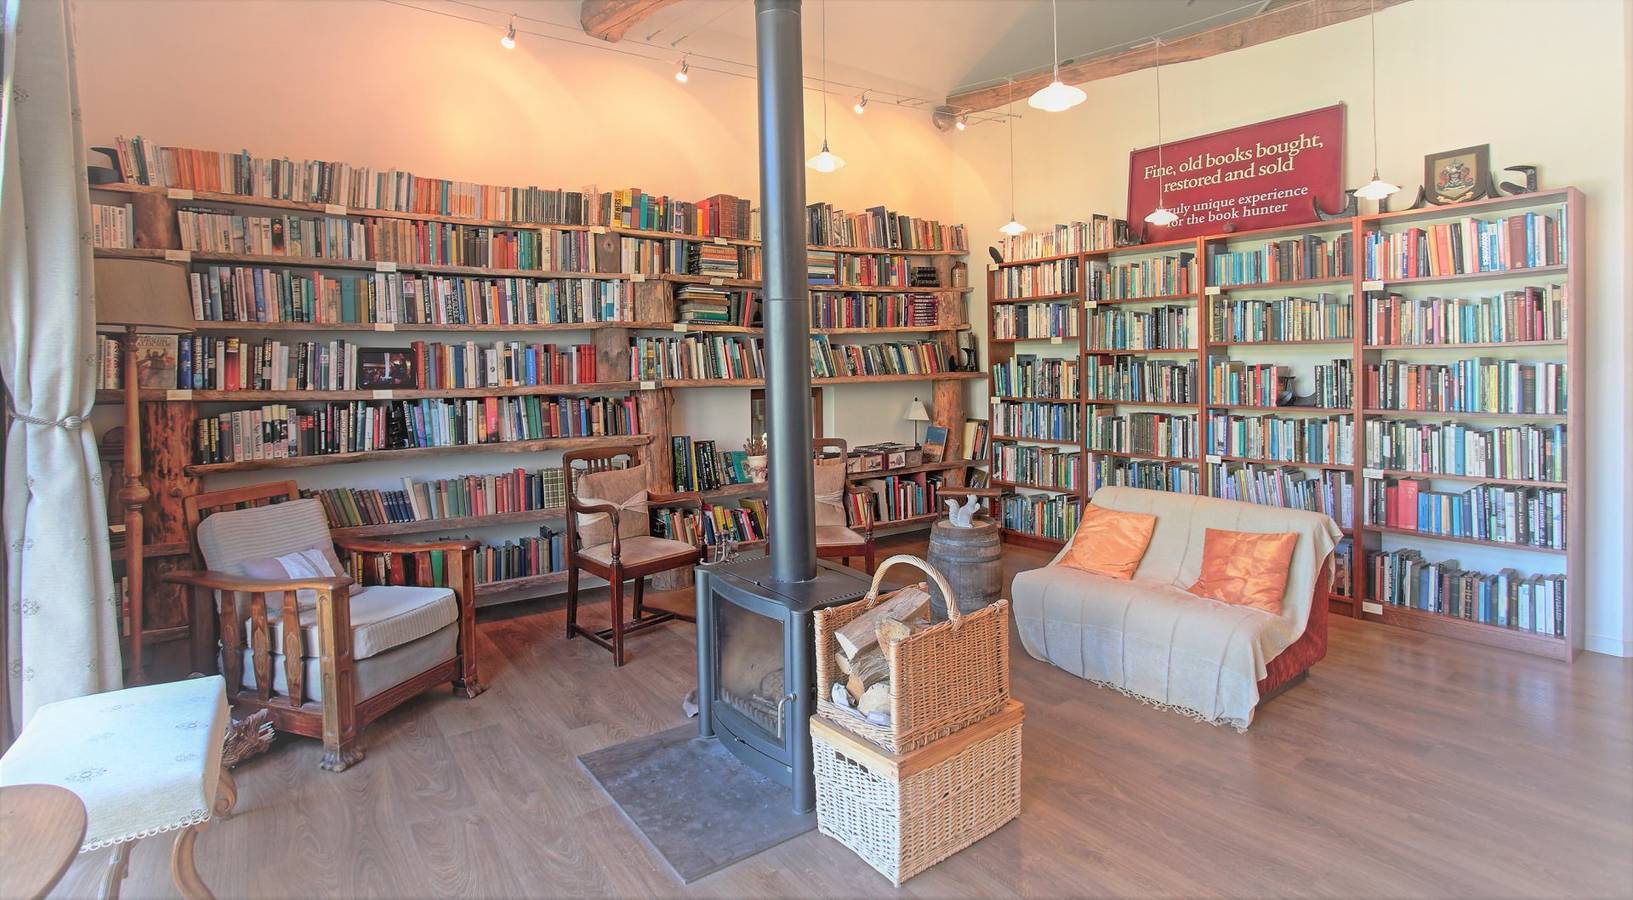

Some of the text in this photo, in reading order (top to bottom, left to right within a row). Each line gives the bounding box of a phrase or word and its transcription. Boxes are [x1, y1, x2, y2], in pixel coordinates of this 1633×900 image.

[1144, 133, 1323, 180] Fine, old books bought,
[1164, 156, 1295, 192] restored and sold
[1166, 186, 1308, 216] ruly unique experience
[1187, 214, 1205, 225] the
[1208, 207, 1239, 222] book
[1242, 203, 1288, 217] hunter
